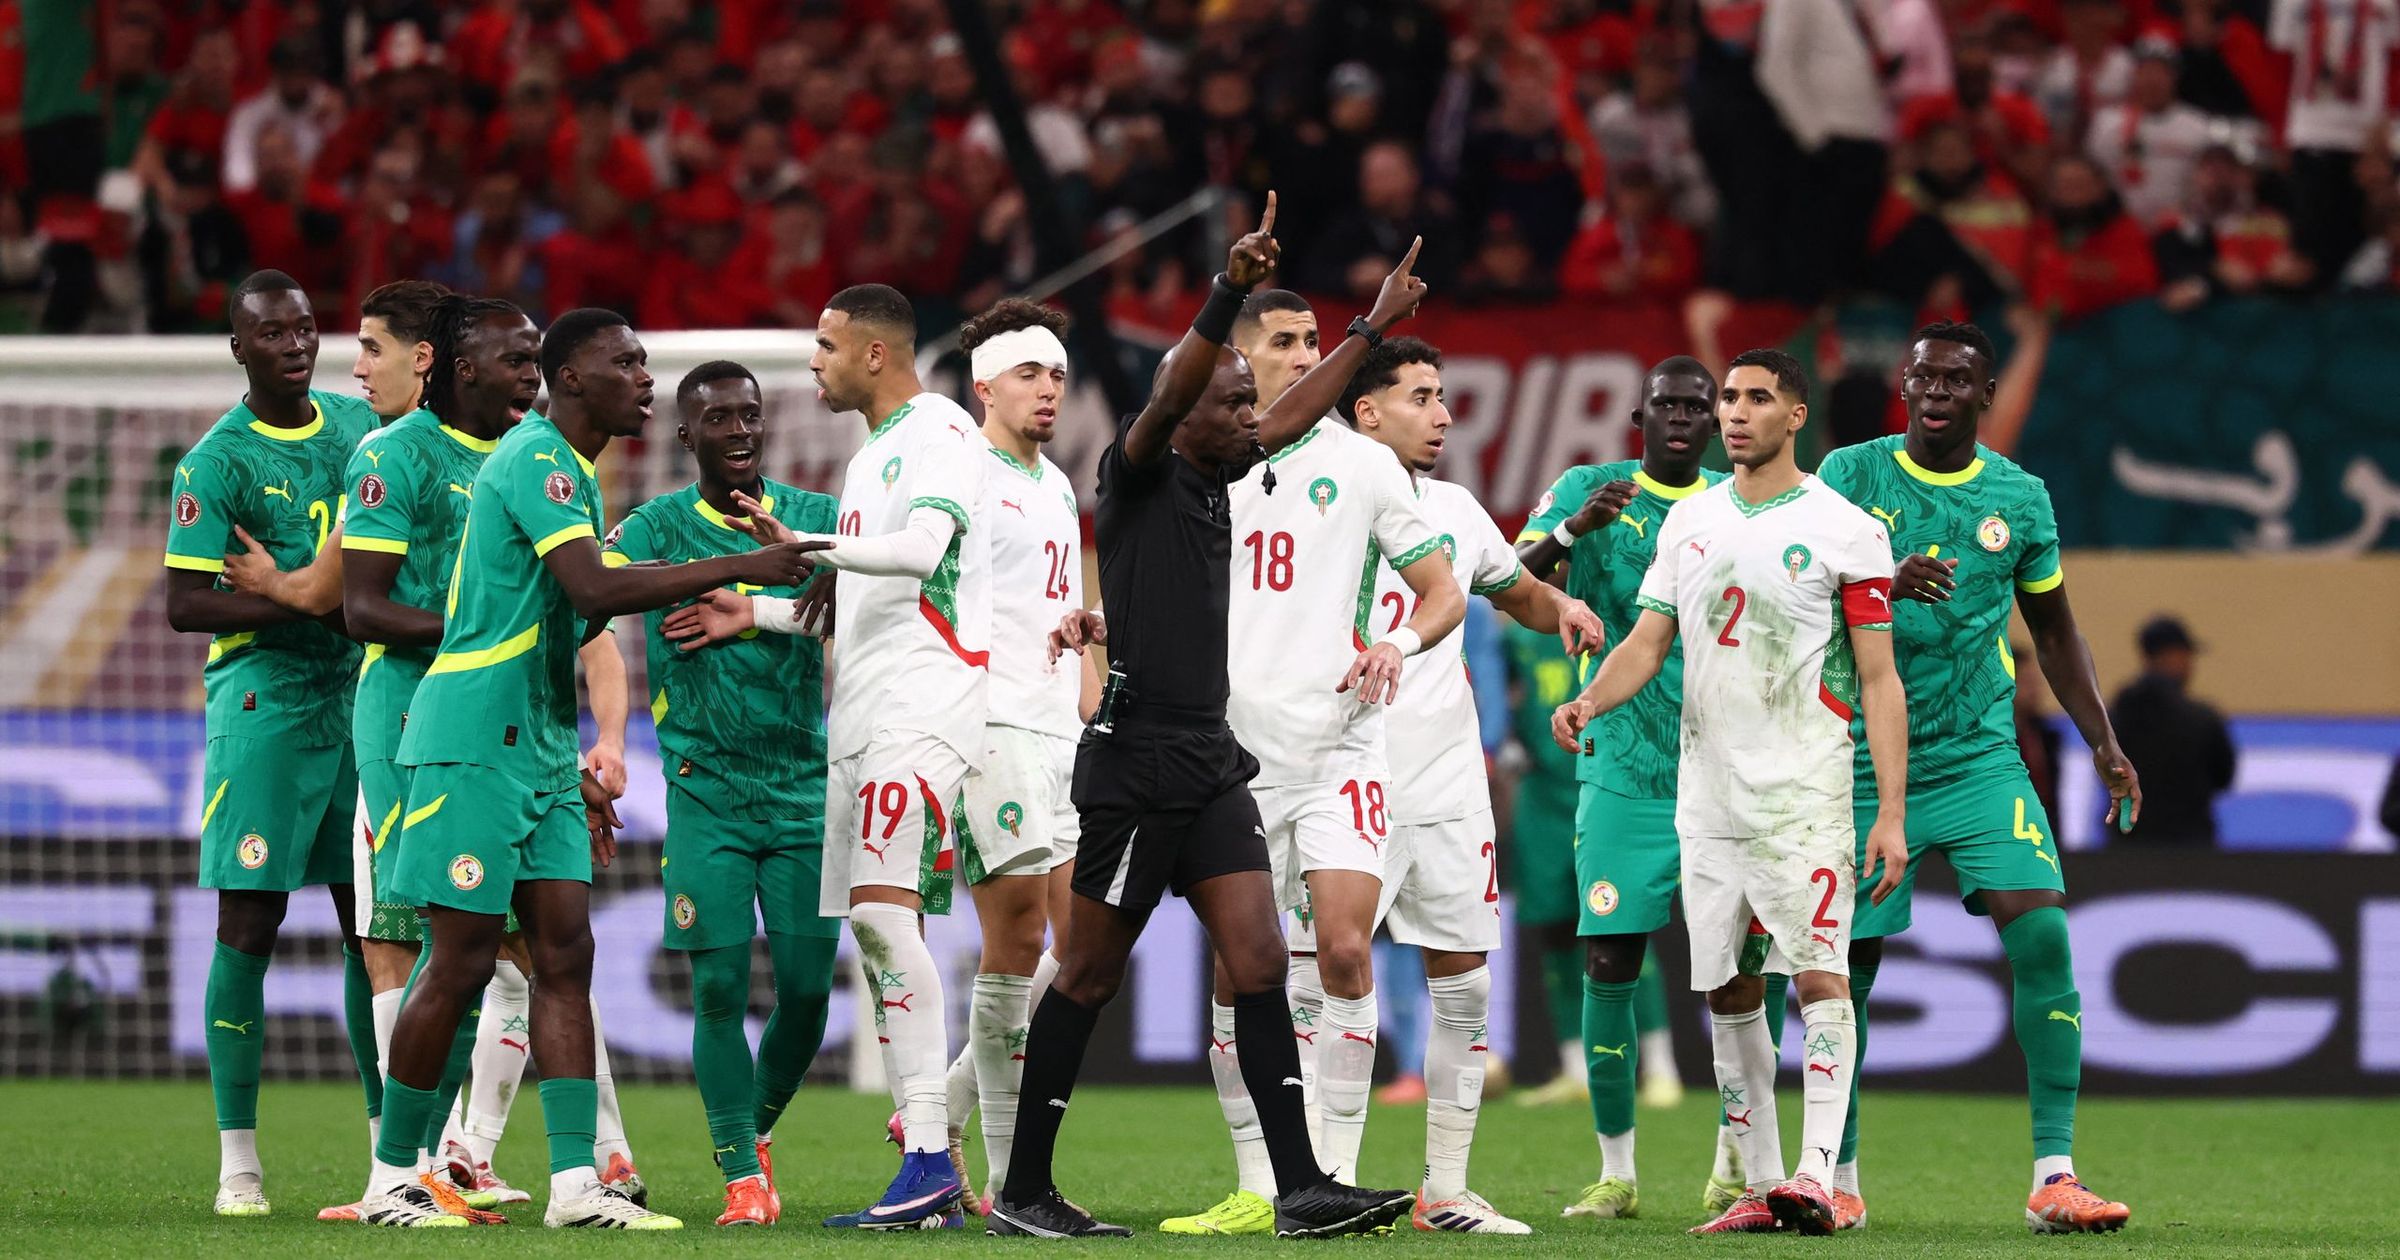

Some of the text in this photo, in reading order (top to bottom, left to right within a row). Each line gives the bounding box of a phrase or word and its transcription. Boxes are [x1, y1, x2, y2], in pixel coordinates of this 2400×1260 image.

[2112, 430, 2400, 558] رب
[1045, 540, 1069, 601] 24
[1244, 530, 1294, 592] 18
[1381, 591, 1423, 634] 2
[1717, 586, 1746, 648] 2
[858, 781, 908, 840] 19
[1339, 779, 1387, 837] 18
[2013, 797, 2044, 846] 4
[1810, 867, 1839, 928] 2
[1700, 891, 2400, 1076] SC
